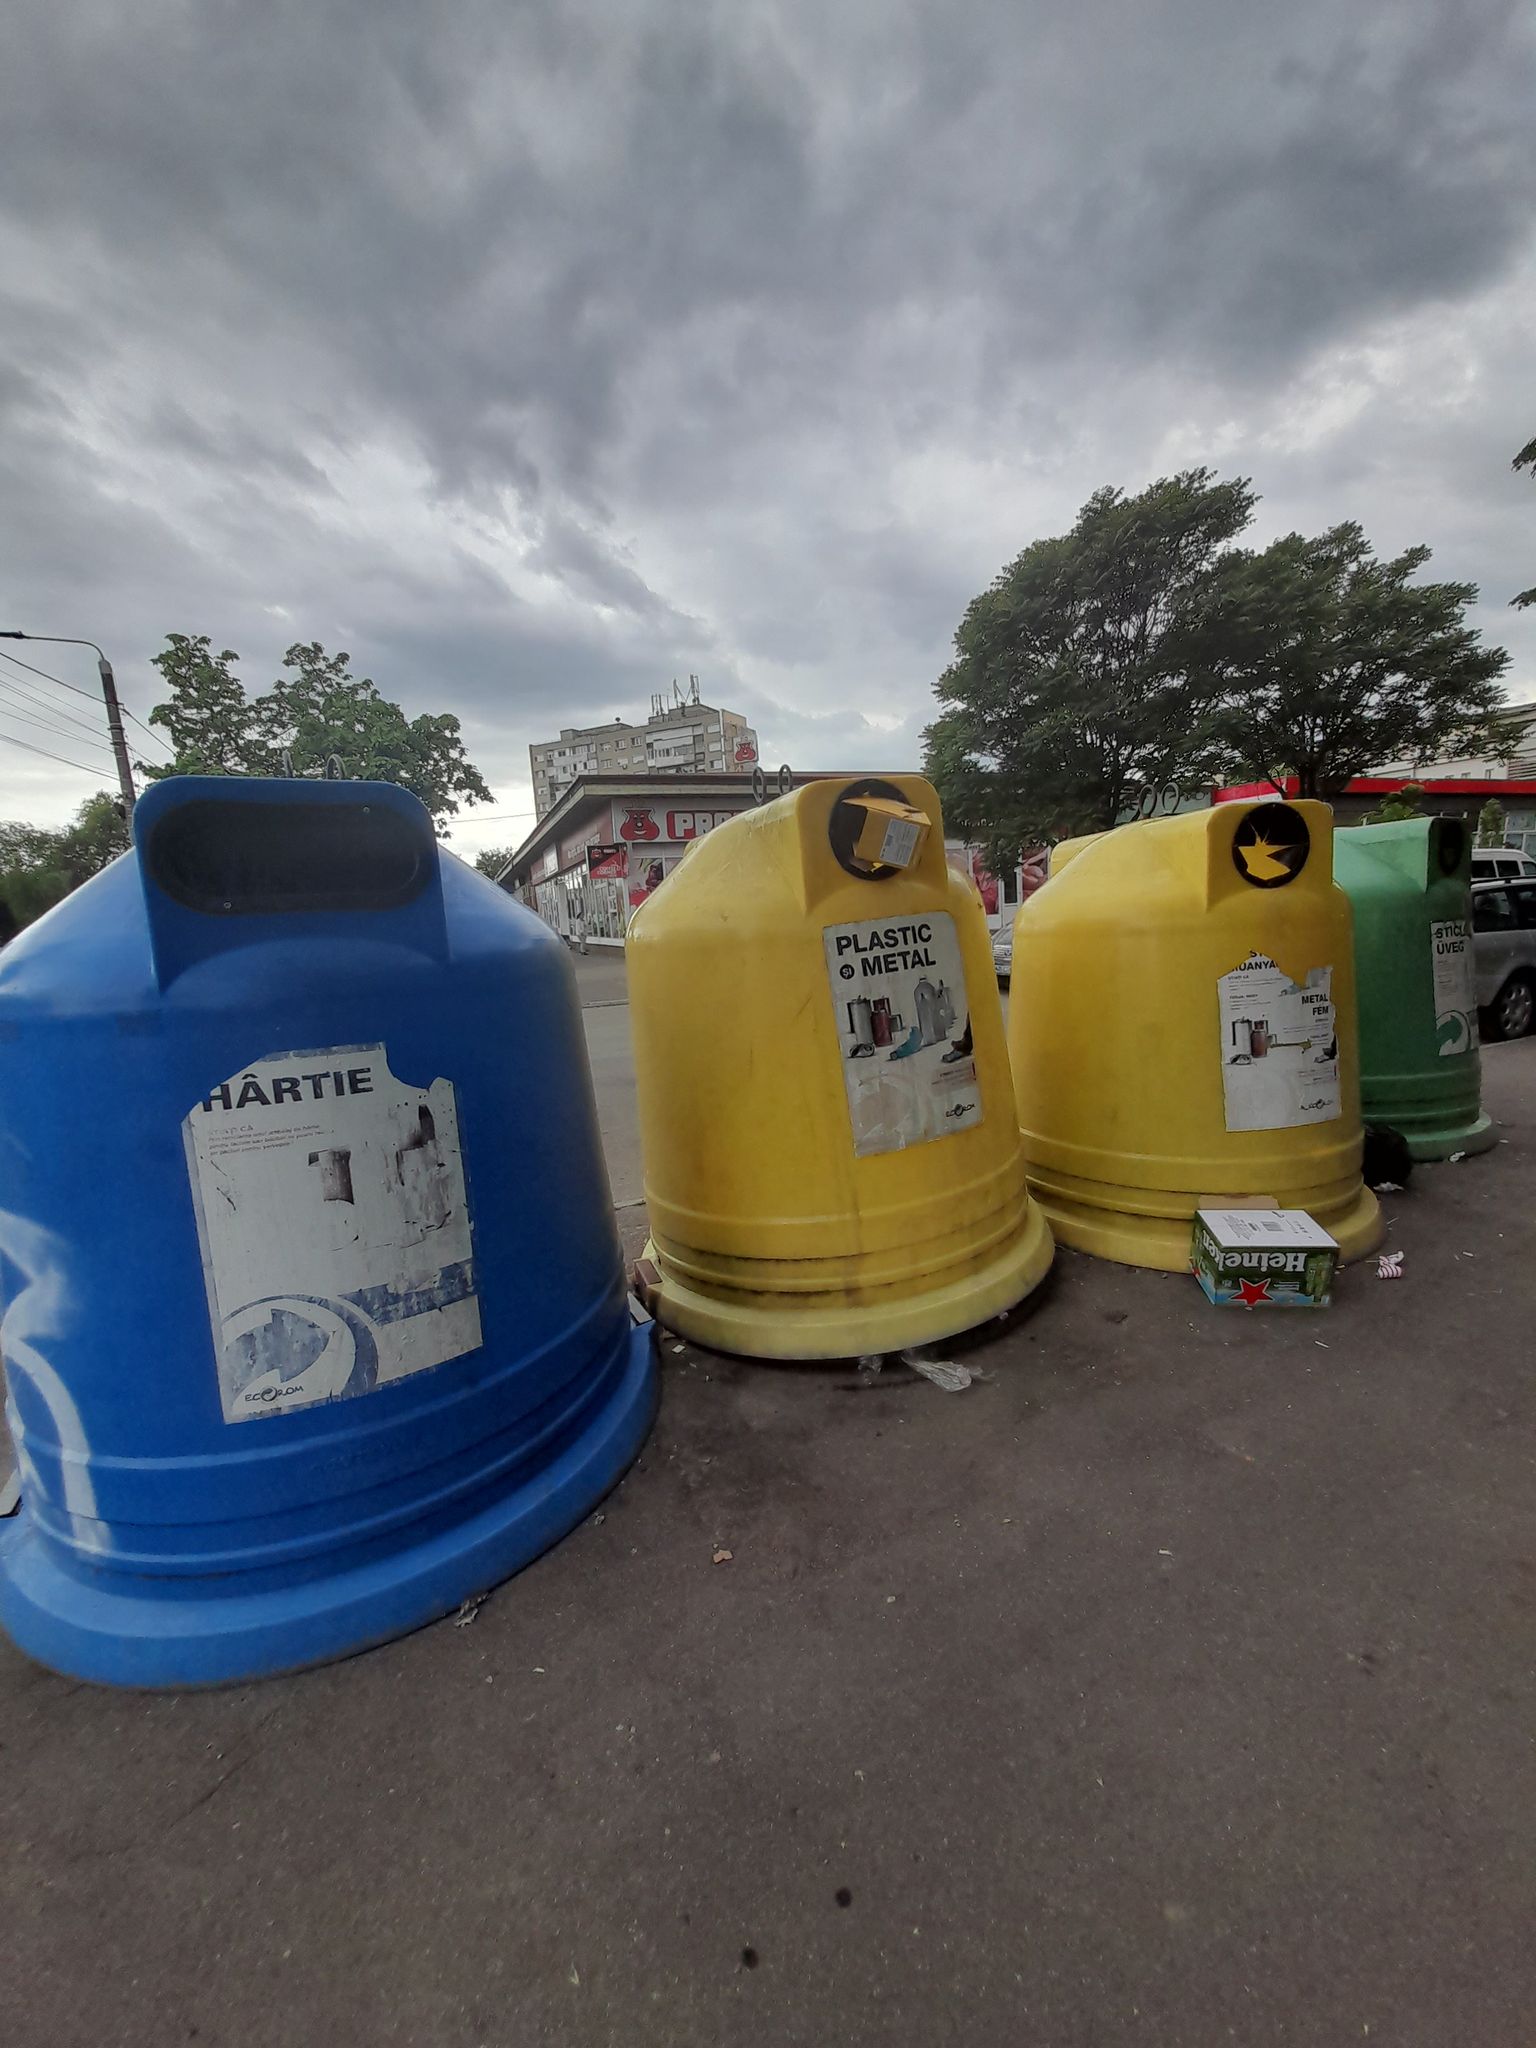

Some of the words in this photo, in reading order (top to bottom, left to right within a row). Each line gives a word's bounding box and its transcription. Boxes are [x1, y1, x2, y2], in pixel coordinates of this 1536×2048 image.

[836, 924, 932, 956] PLASTIC
[861, 948, 937, 977] METAL
[1301, 993, 1329, 1005] METAL
[203, 1067, 374, 1112] HÂRTIE
